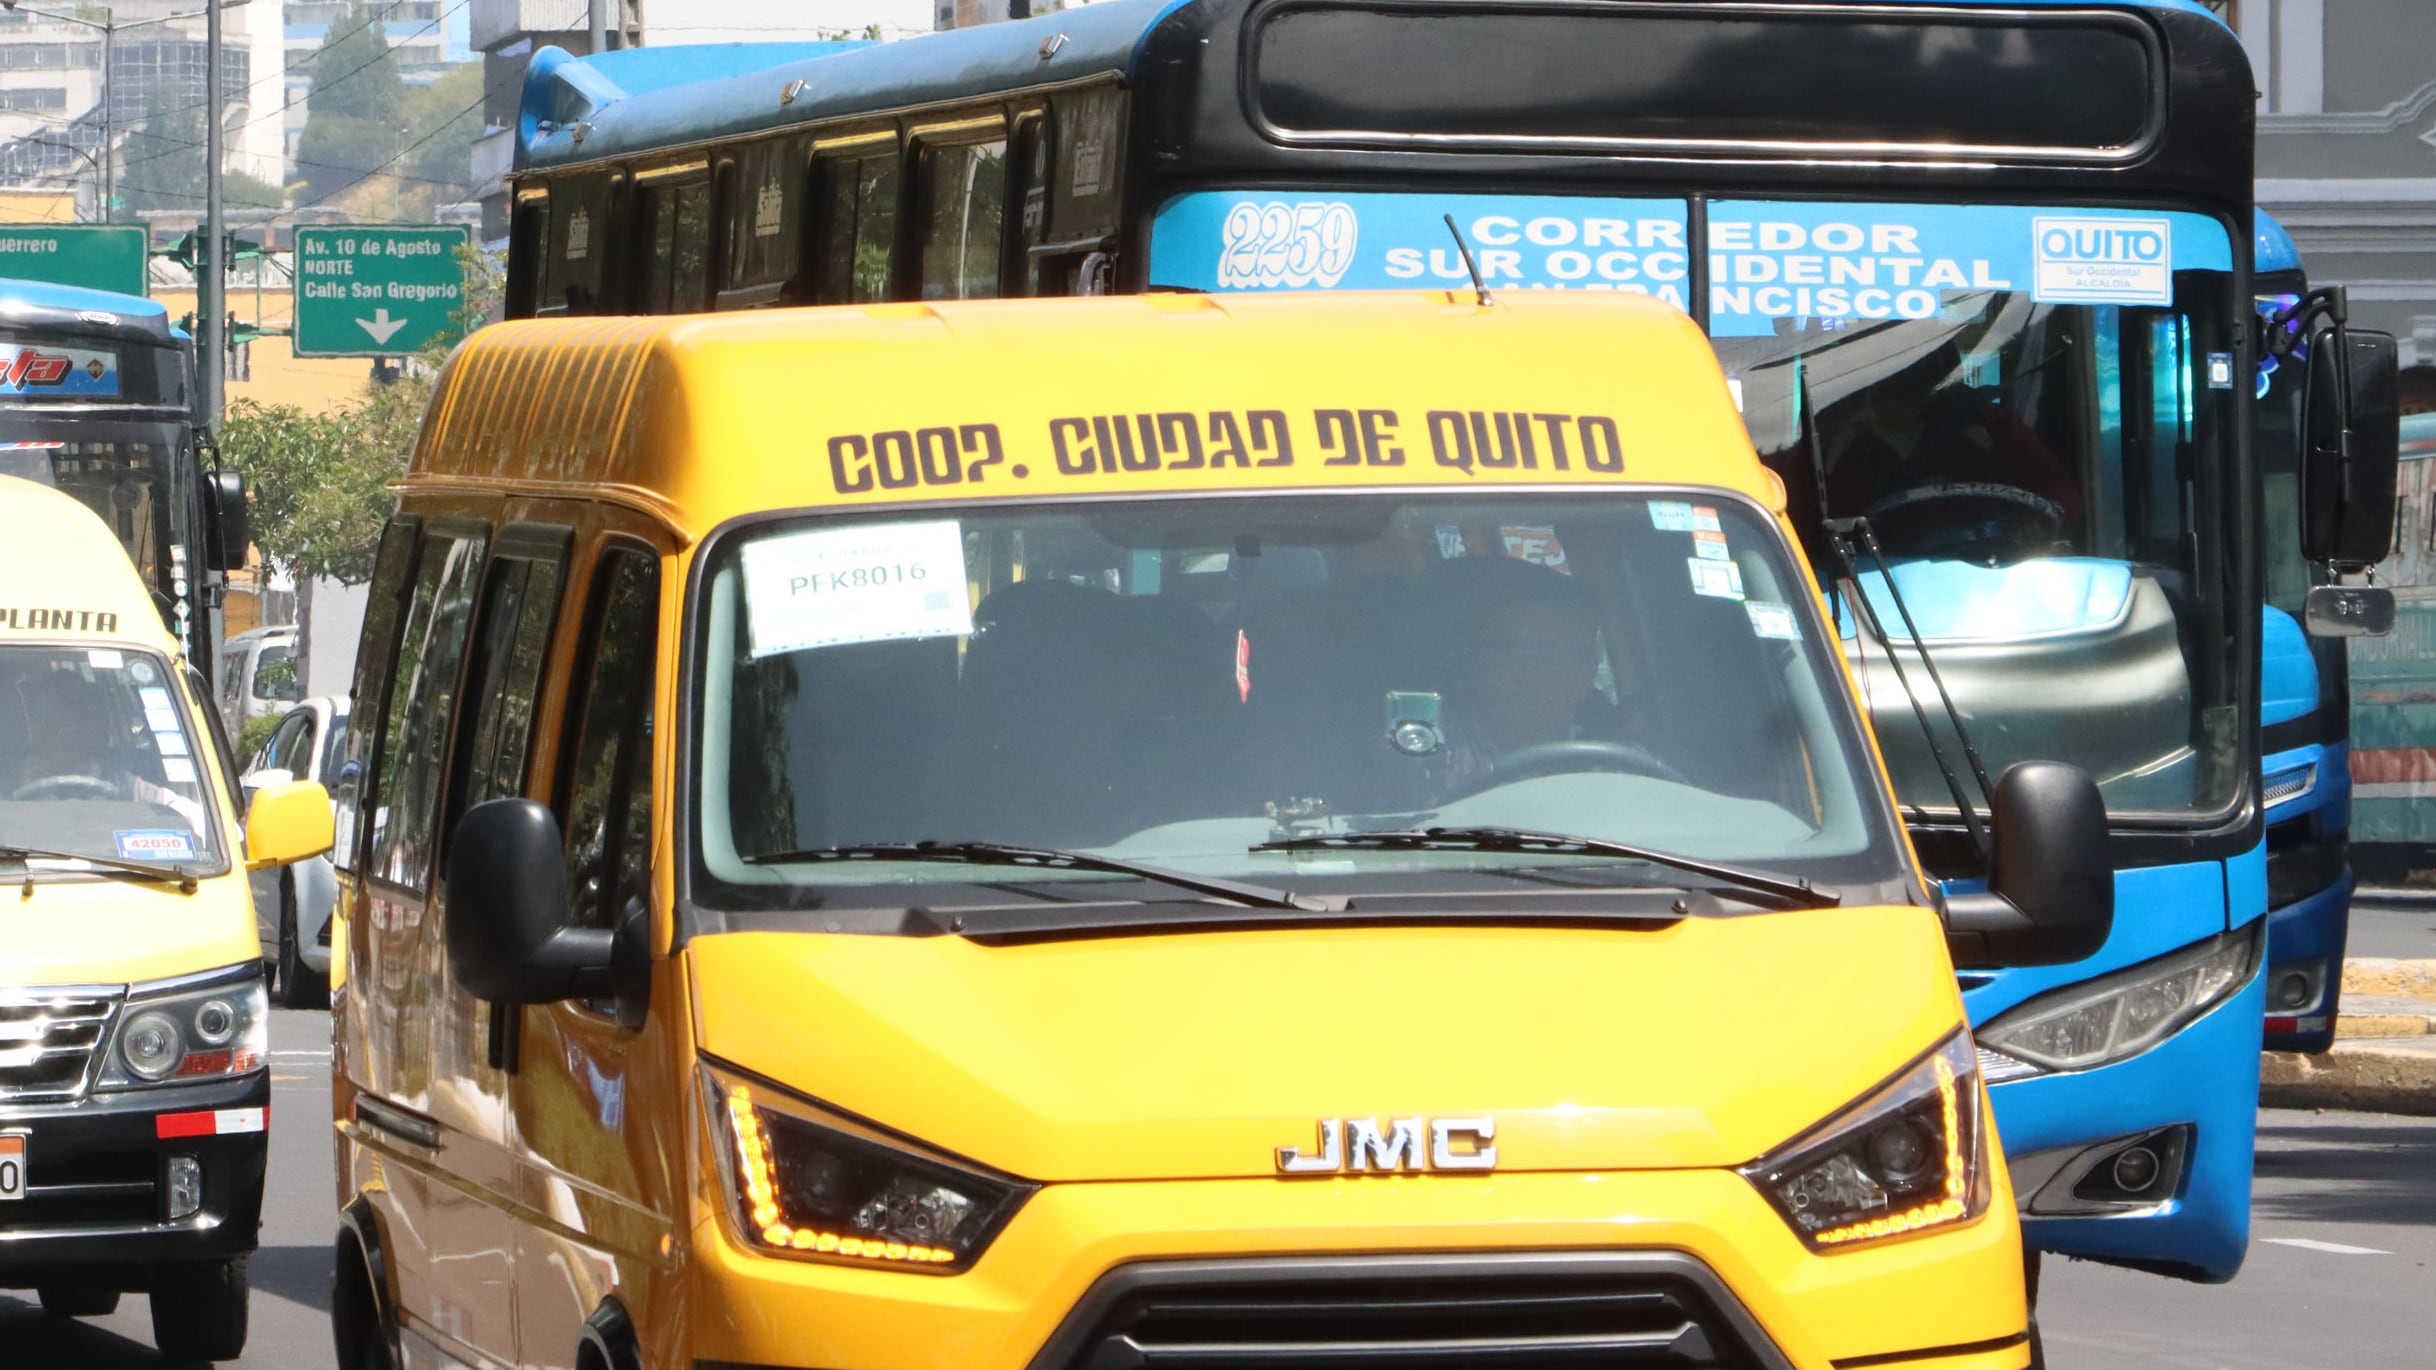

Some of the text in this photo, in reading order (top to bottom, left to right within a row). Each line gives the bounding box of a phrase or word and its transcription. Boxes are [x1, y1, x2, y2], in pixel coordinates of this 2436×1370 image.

[305, 238, 441, 258] Av. 10 de Agosto
[1217, 201, 1359, 289] 2259
[2043, 229, 2162, 260] QUITO
[305, 260, 354, 275] NORTE
[1384, 248, 1524, 279] SUR
[2066, 266, 2141, 277] Sur Occidental
[305, 281, 457, 302] Calle San Gregorio
[827, 409, 1625, 494] COOP. CIUDAD DE QUITO
[790, 562, 927, 596] PFK8016
[131, 837, 182, 849] 42050
[1274, 1116, 1497, 1174] JMC
